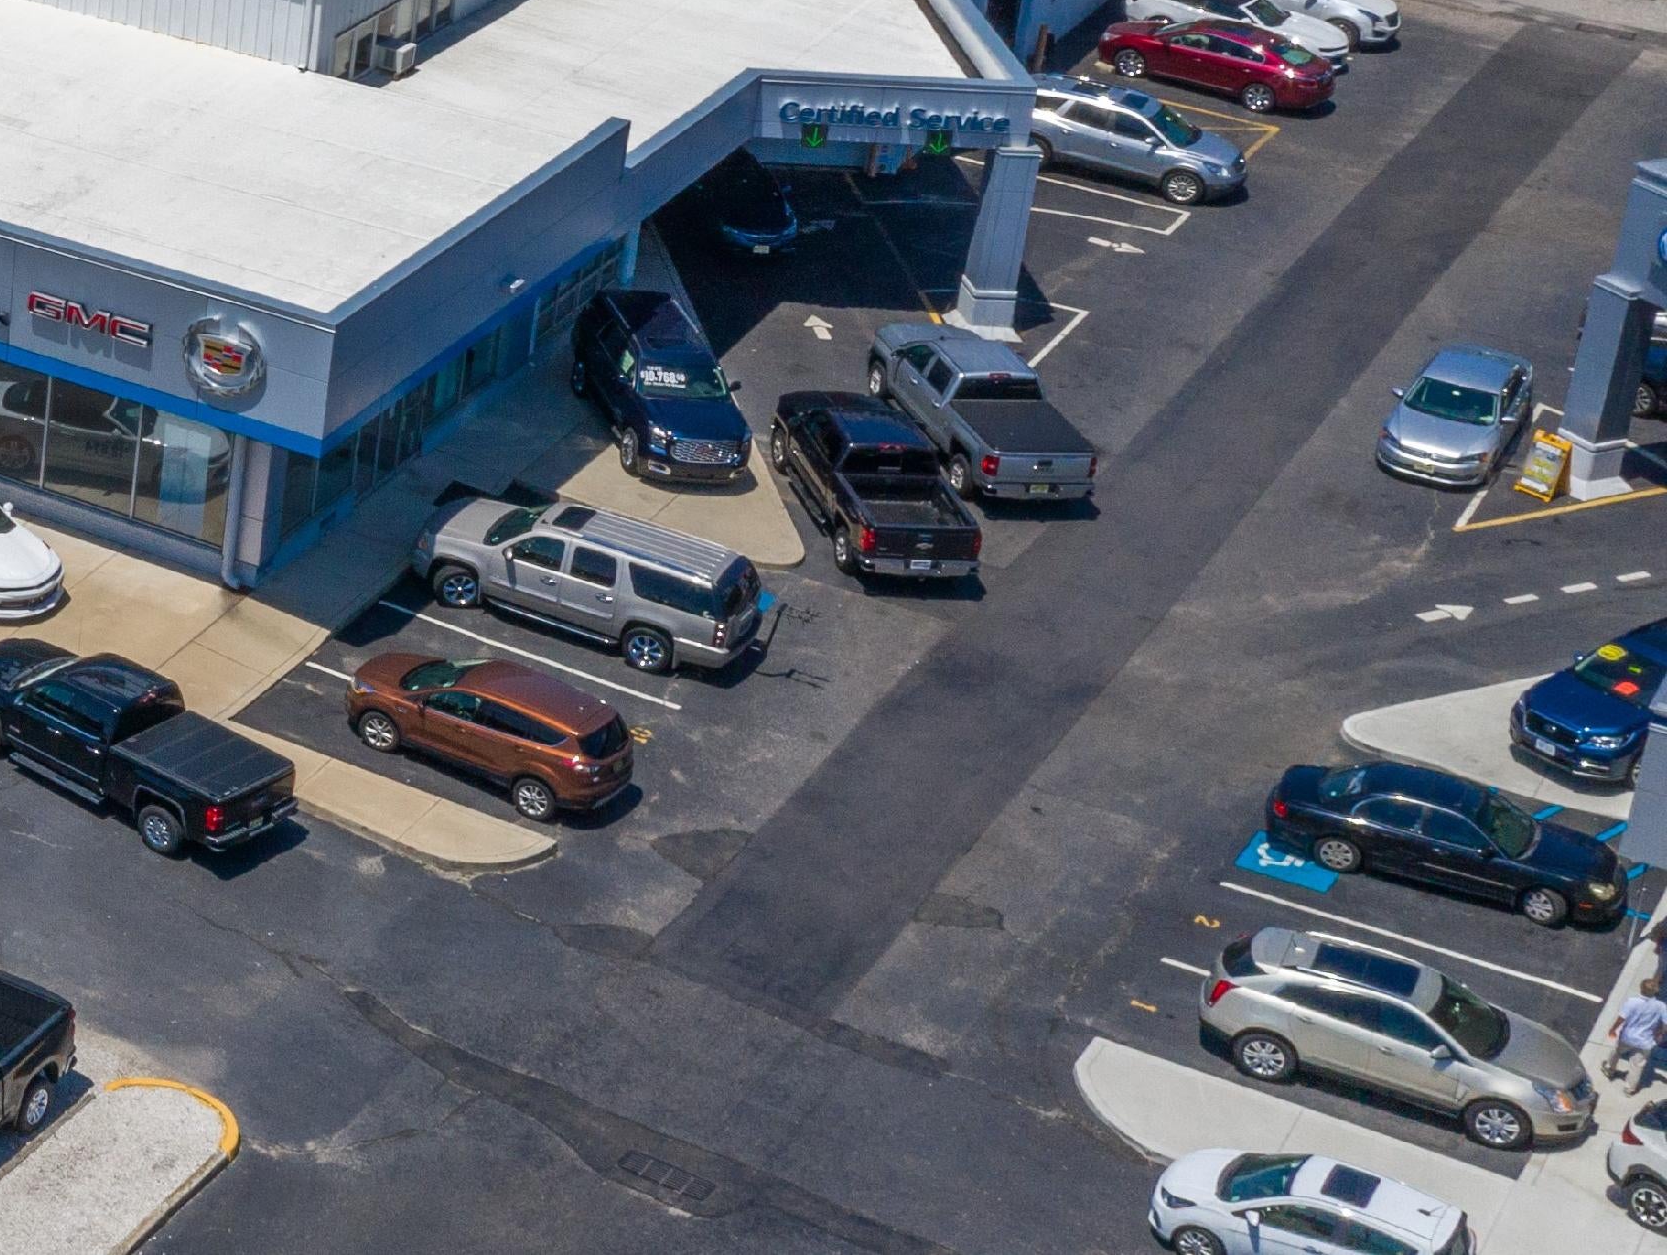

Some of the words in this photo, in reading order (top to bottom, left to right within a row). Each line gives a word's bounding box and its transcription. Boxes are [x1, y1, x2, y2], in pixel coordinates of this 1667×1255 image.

[778, 100, 901, 127] Certified
[907, 107, 1011, 132] Service
[26, 289, 153, 348] GMC
